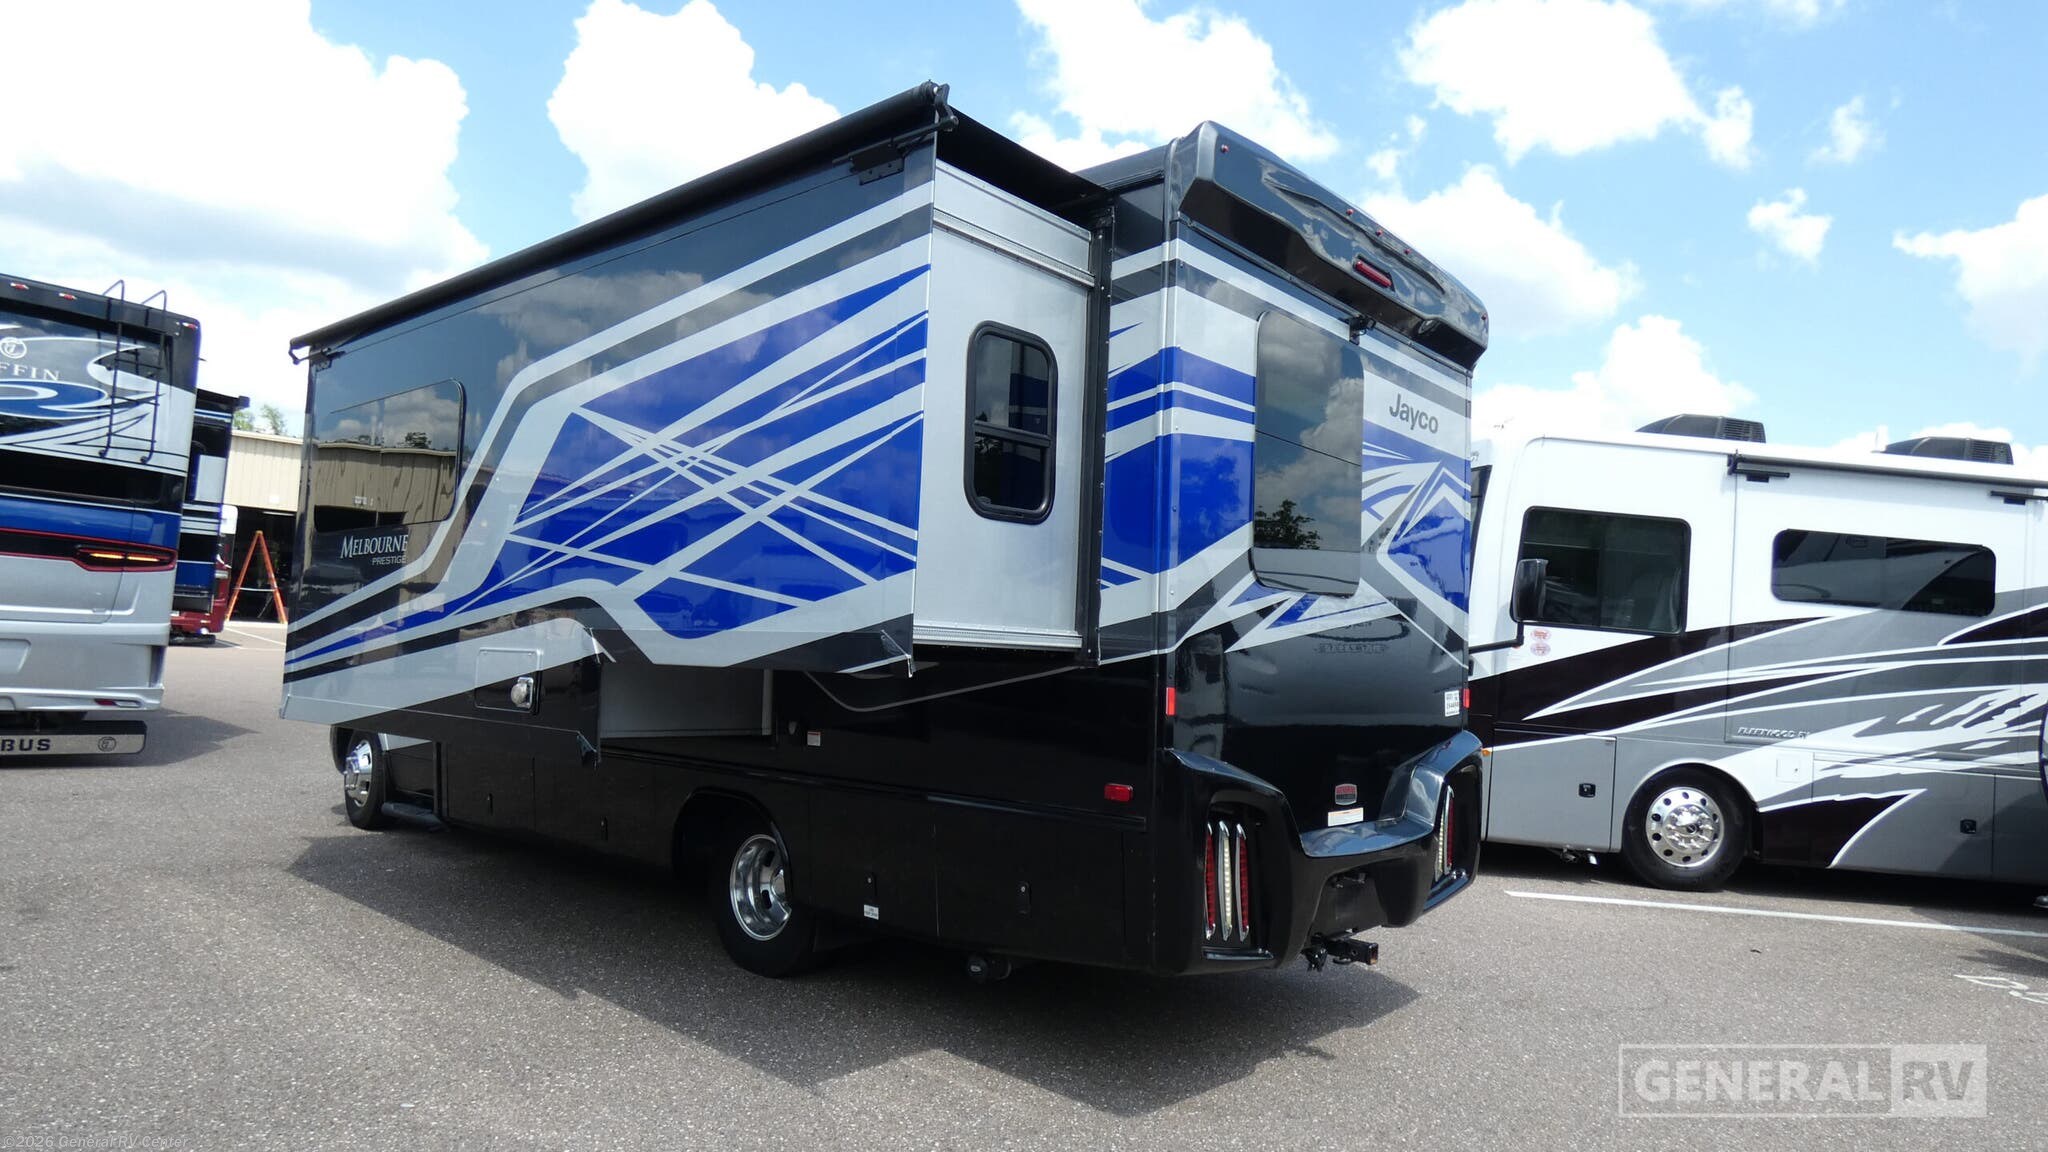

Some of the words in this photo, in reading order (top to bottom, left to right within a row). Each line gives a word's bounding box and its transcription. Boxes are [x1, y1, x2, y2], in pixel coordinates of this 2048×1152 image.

[1389, 393, 1439, 434] Jayco
[340, 534, 409, 559] MELBOURNE
[372, 555, 407, 566] PRESTIGE
[0, 738, 51, 752] BUS
